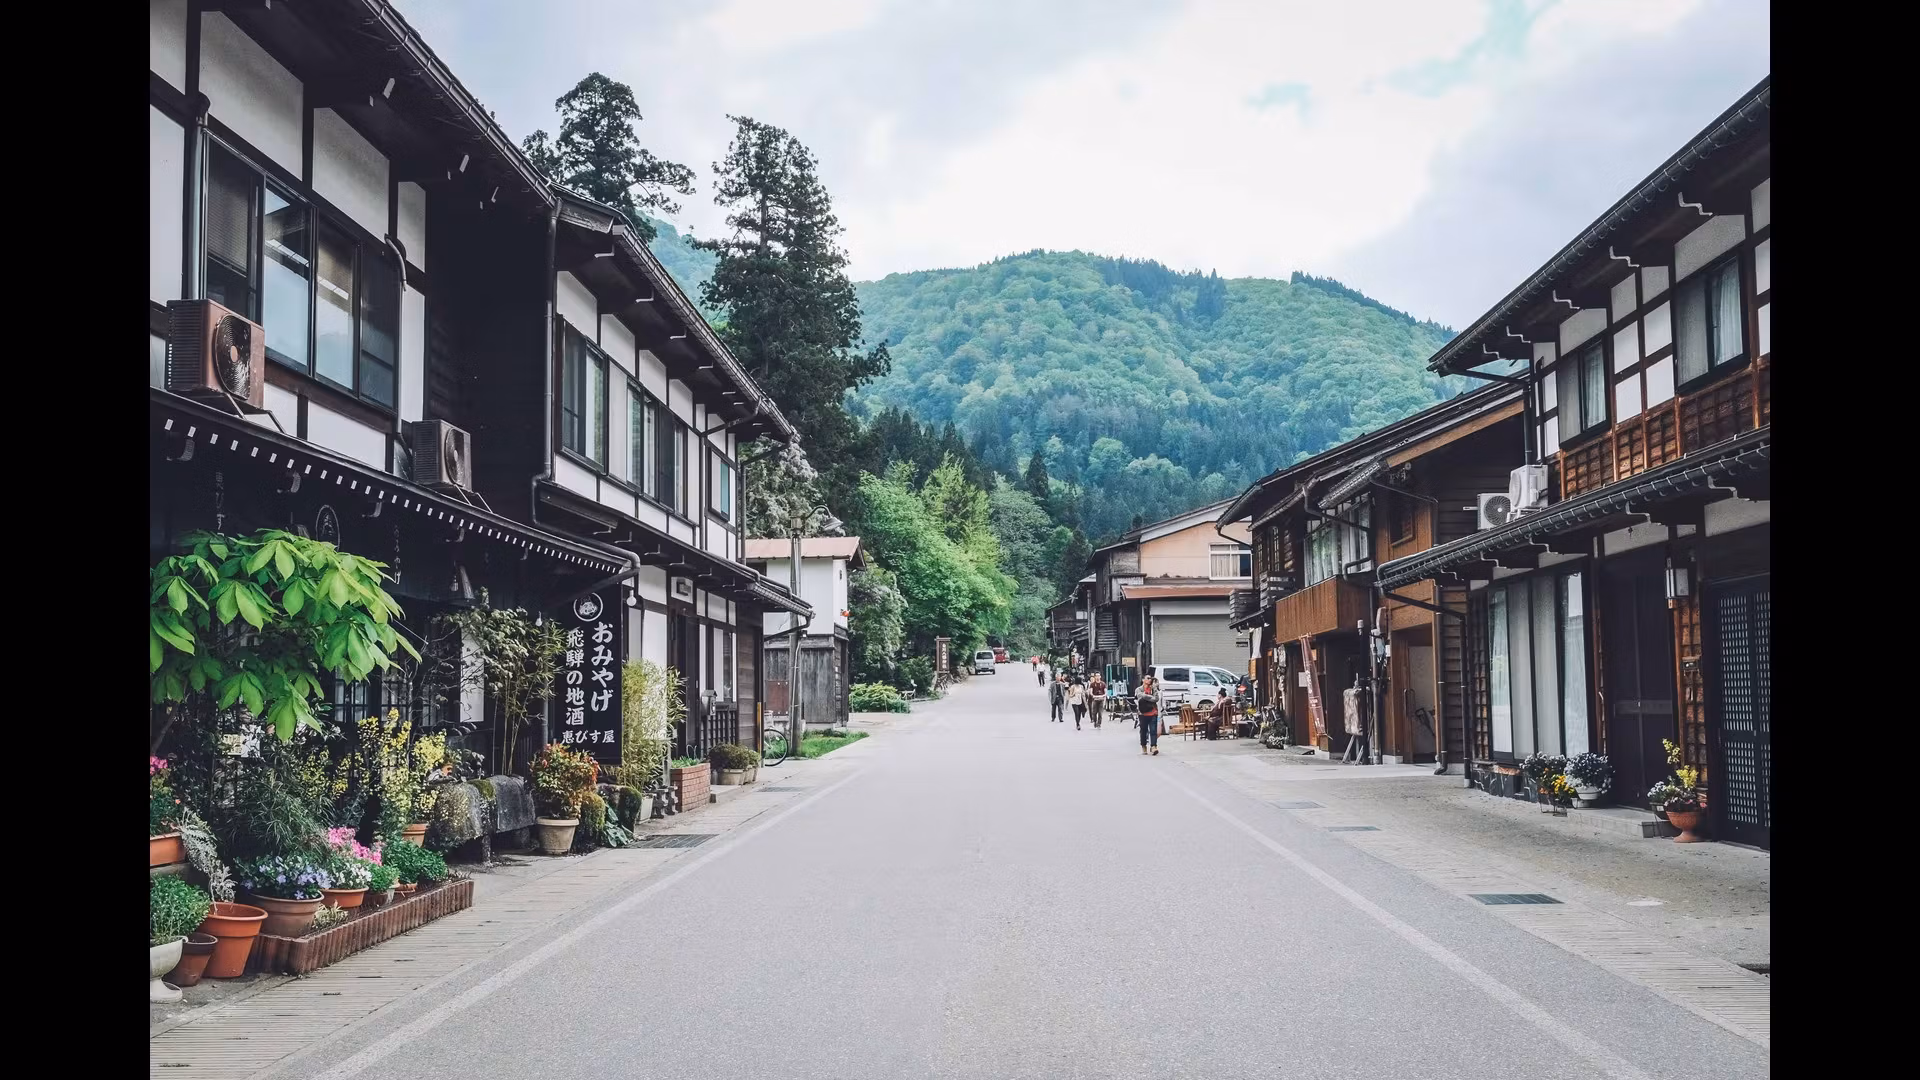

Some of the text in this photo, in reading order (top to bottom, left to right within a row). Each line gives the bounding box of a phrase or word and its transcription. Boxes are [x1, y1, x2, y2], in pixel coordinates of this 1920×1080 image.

[591, 622, 614, 712] おみやげ
[562, 730, 615, 744] 恵びす屋
